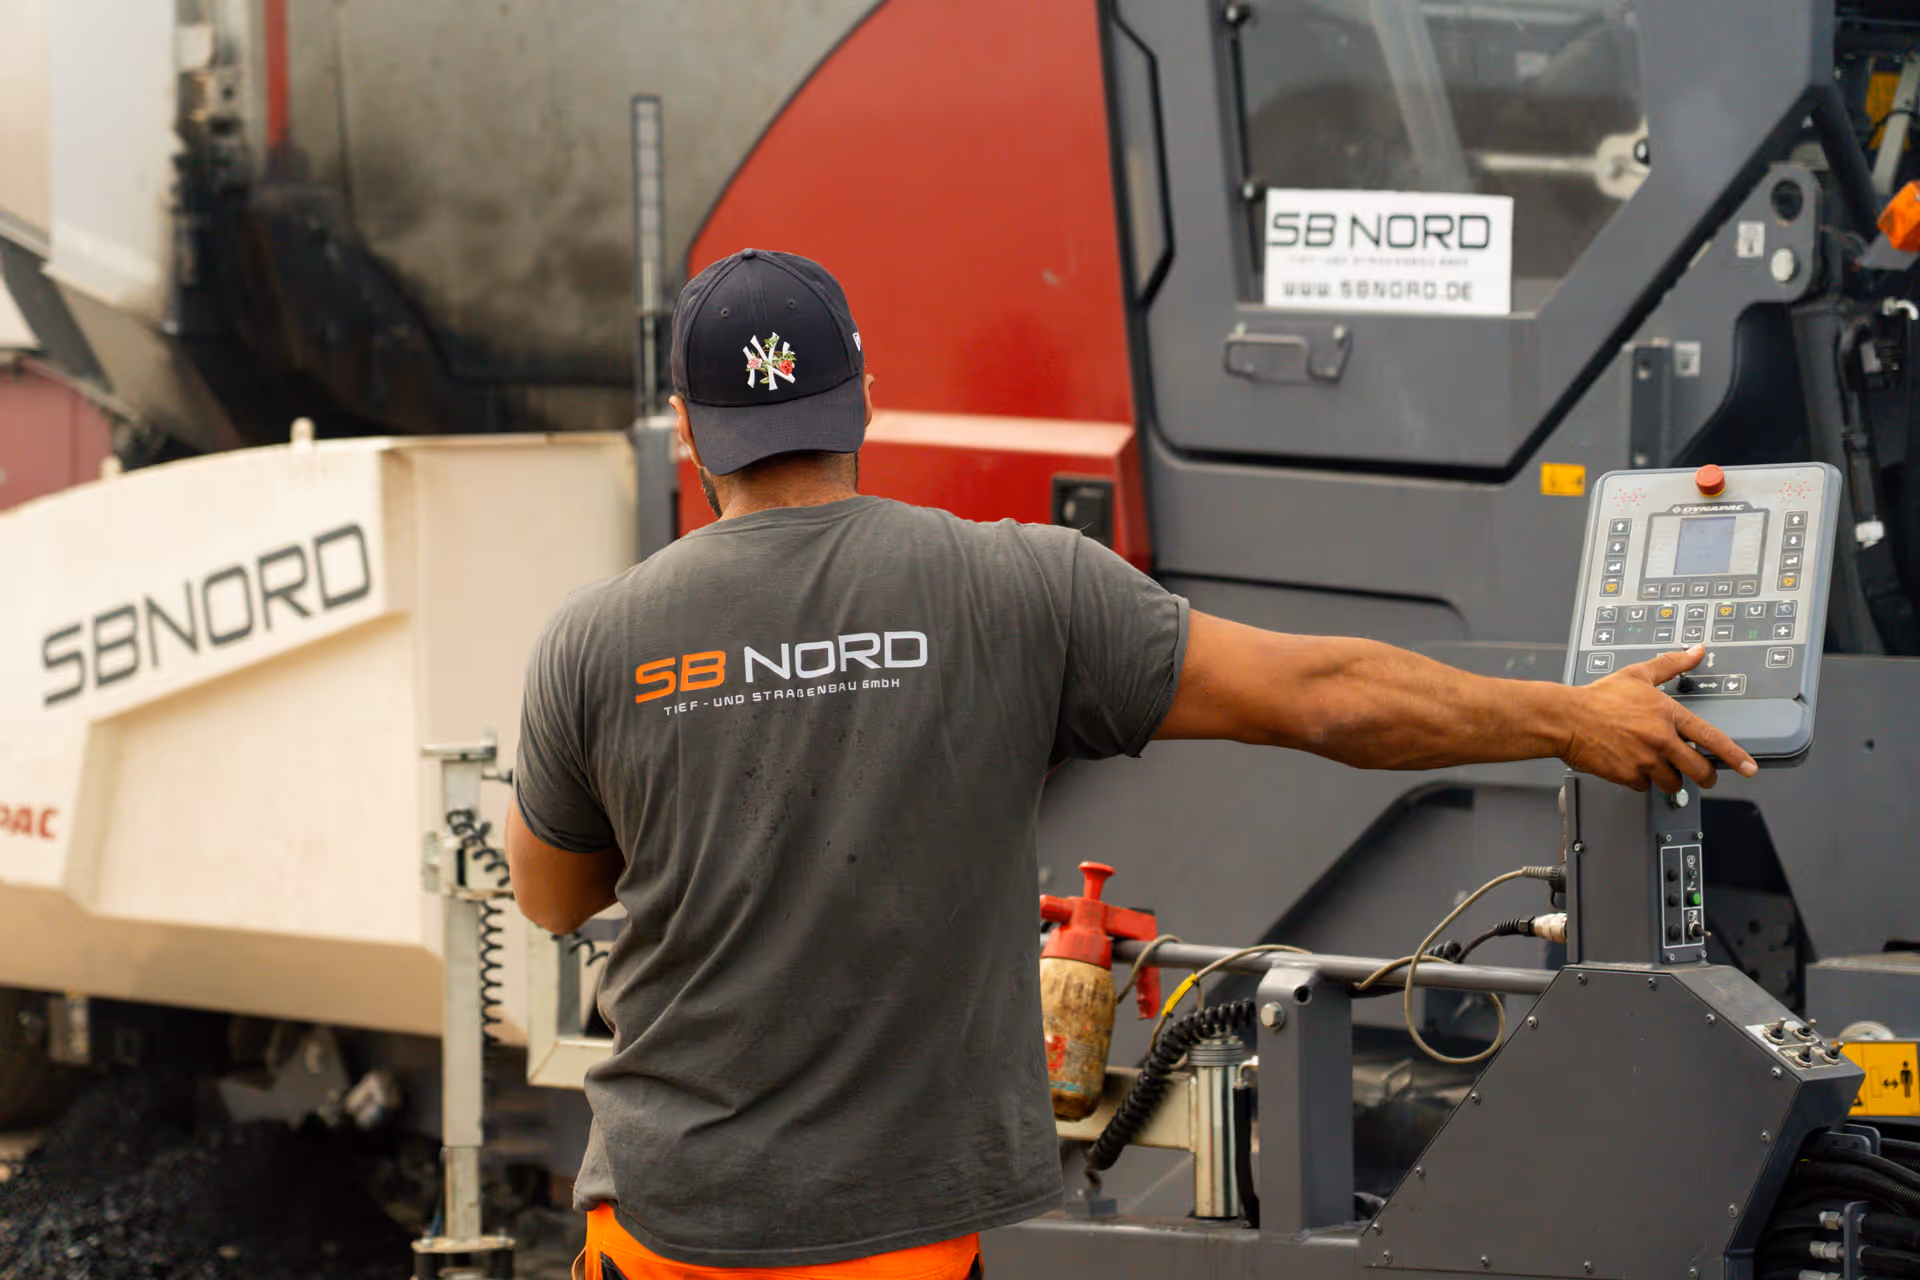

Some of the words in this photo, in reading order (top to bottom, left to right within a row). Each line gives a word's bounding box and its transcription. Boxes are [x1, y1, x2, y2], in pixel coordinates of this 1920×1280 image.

[1266, 212, 1336, 247] SB
[1350, 213, 1491, 250] NORD
[743, 332, 796, 391] NY
[1682, 504, 1745, 513] DYNAPAC
[42, 521, 372, 707] SBNORD
[635, 650, 727, 704] SB
[743, 630, 929, 684] NORD
[862, 677, 901, 690] GmbH
